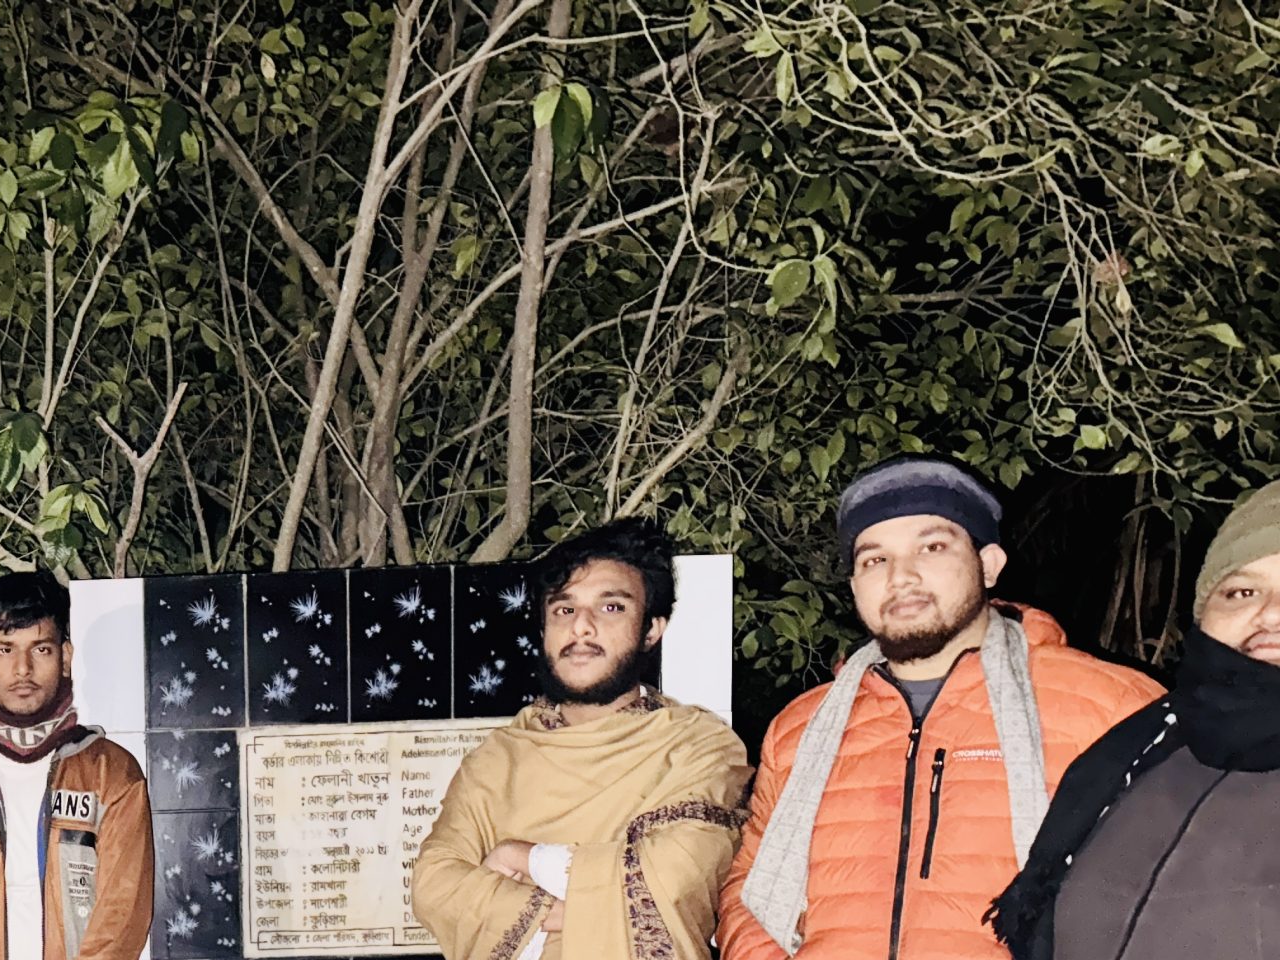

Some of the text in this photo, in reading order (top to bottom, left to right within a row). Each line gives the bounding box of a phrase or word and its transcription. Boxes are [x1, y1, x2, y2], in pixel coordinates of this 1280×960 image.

[254, 777, 274, 789] নাম
[311, 769, 353, 787] ফেলানী
[357, 772, 391, 789] খাতুন
[401, 770, 431, 781] Name
[402, 787, 434, 799] Father
[402, 804, 439, 816] Mother
[403, 823, 423, 837] Age
